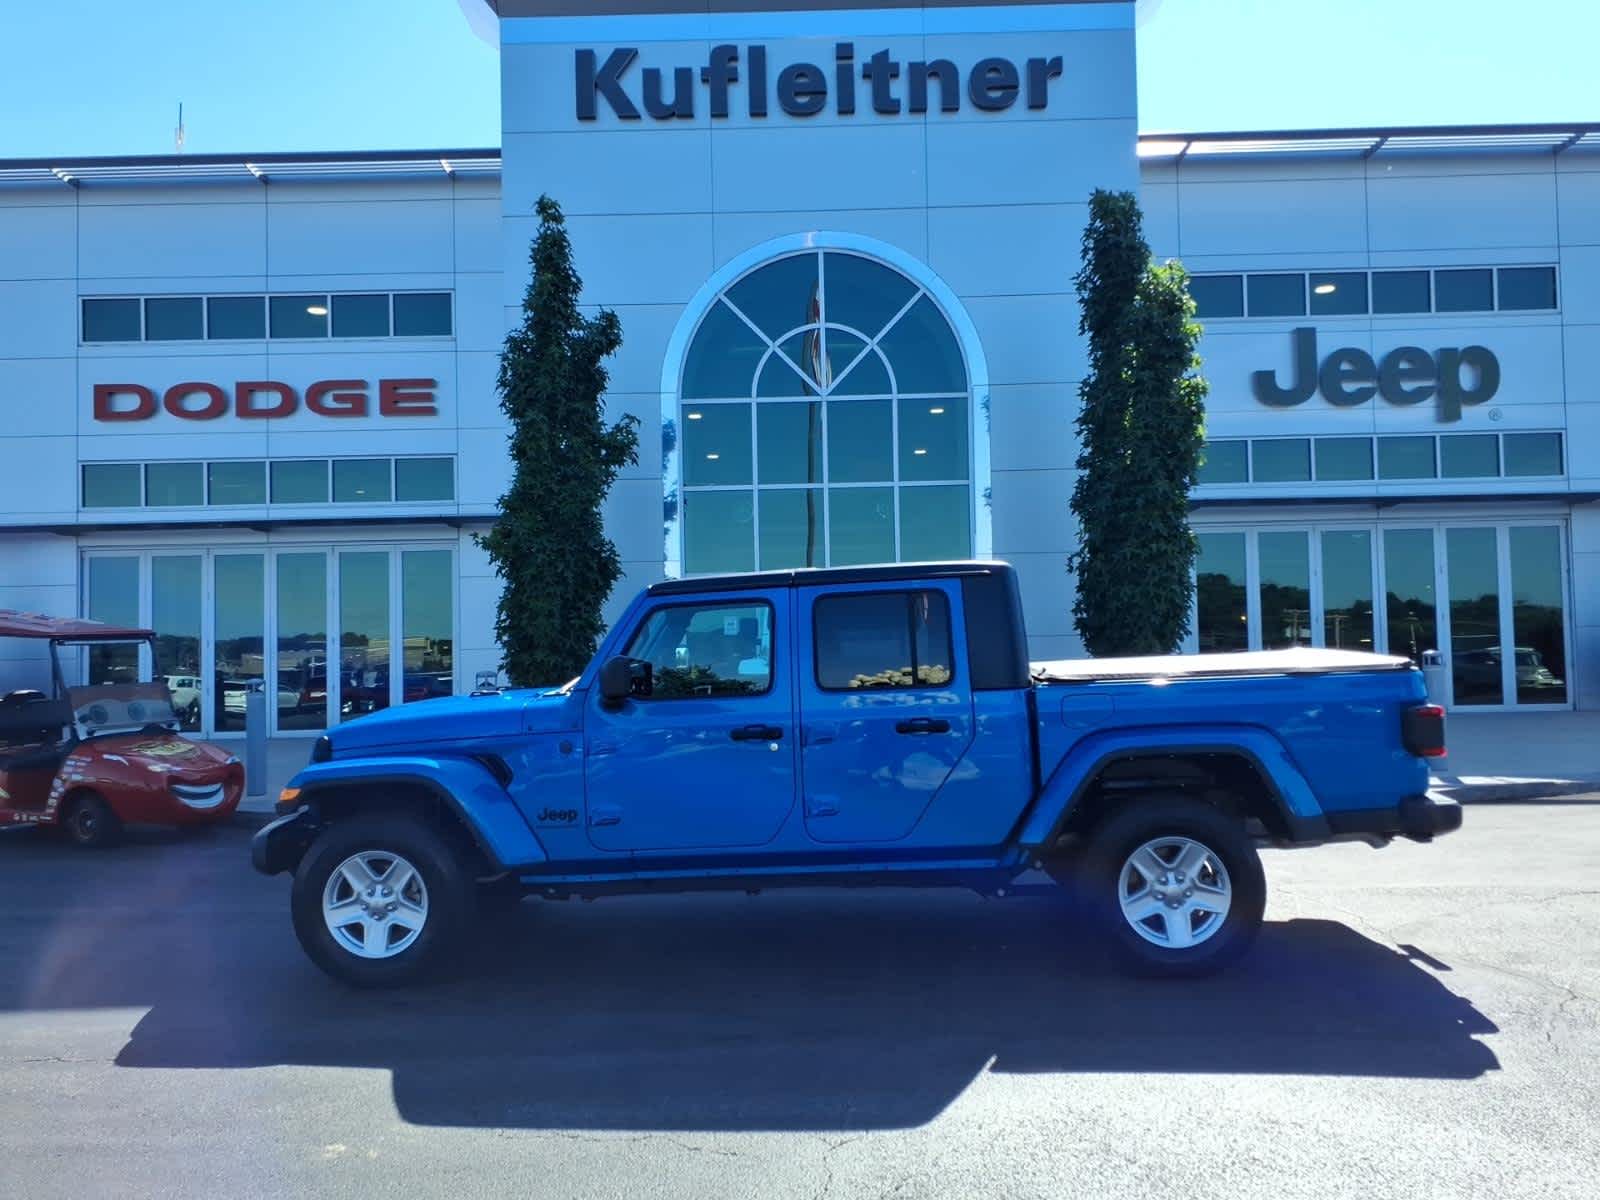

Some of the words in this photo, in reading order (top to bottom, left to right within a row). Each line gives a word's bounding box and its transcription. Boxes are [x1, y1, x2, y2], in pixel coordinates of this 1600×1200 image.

[574, 42, 1063, 121] Kufleitner
[93, 378, 438, 421] DODGE
[1252, 326, 1500, 424] Jeep
[537, 807, 577, 822] Jeep
